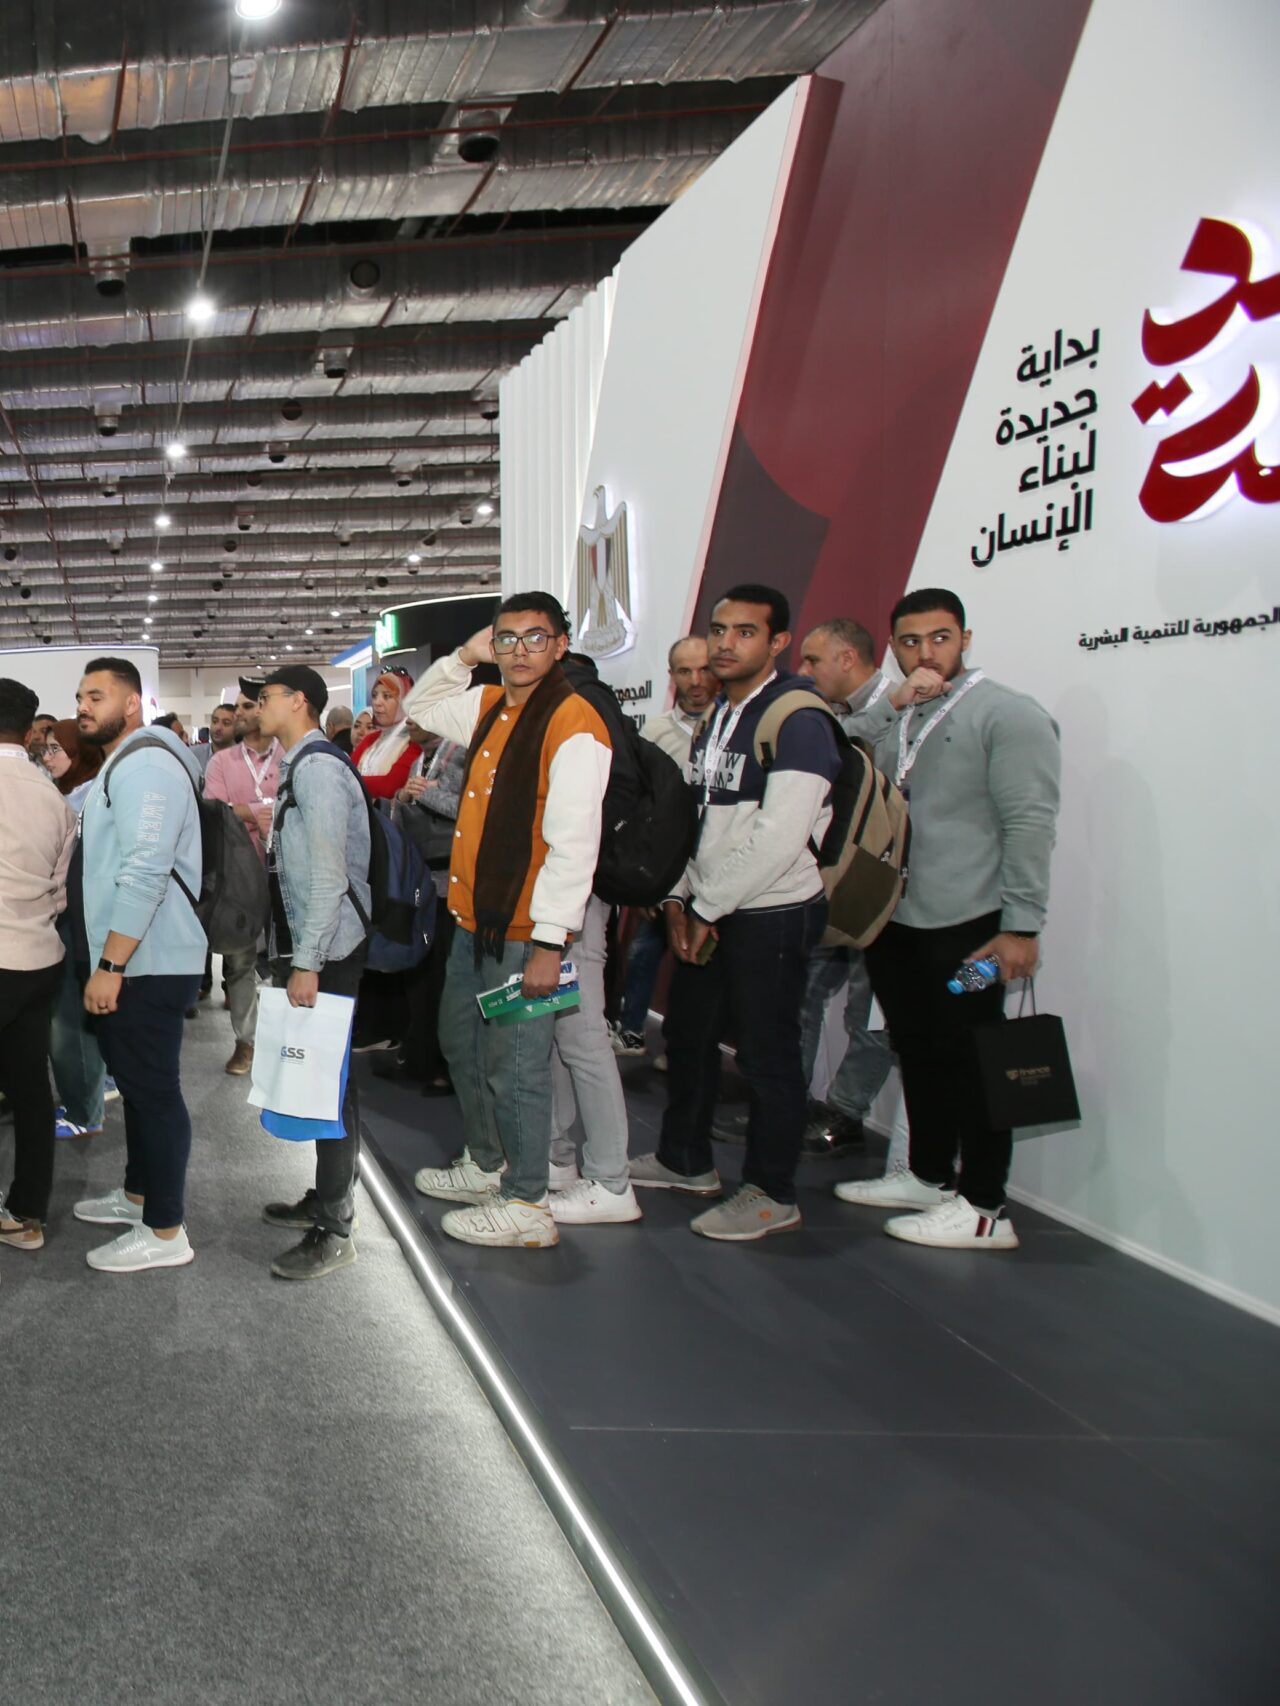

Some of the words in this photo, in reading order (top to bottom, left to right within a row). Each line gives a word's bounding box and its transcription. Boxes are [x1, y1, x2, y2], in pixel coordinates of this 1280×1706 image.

[1017, 328, 1100, 386] بداية
[995, 388, 1098, 446] جديدة
[1019, 429, 1096, 493] لبناء
[971, 488, 1094, 568] الإنسان
[1078, 627, 1129, 650] البشرية
[1132, 619, 1189, 644] للتنمية
